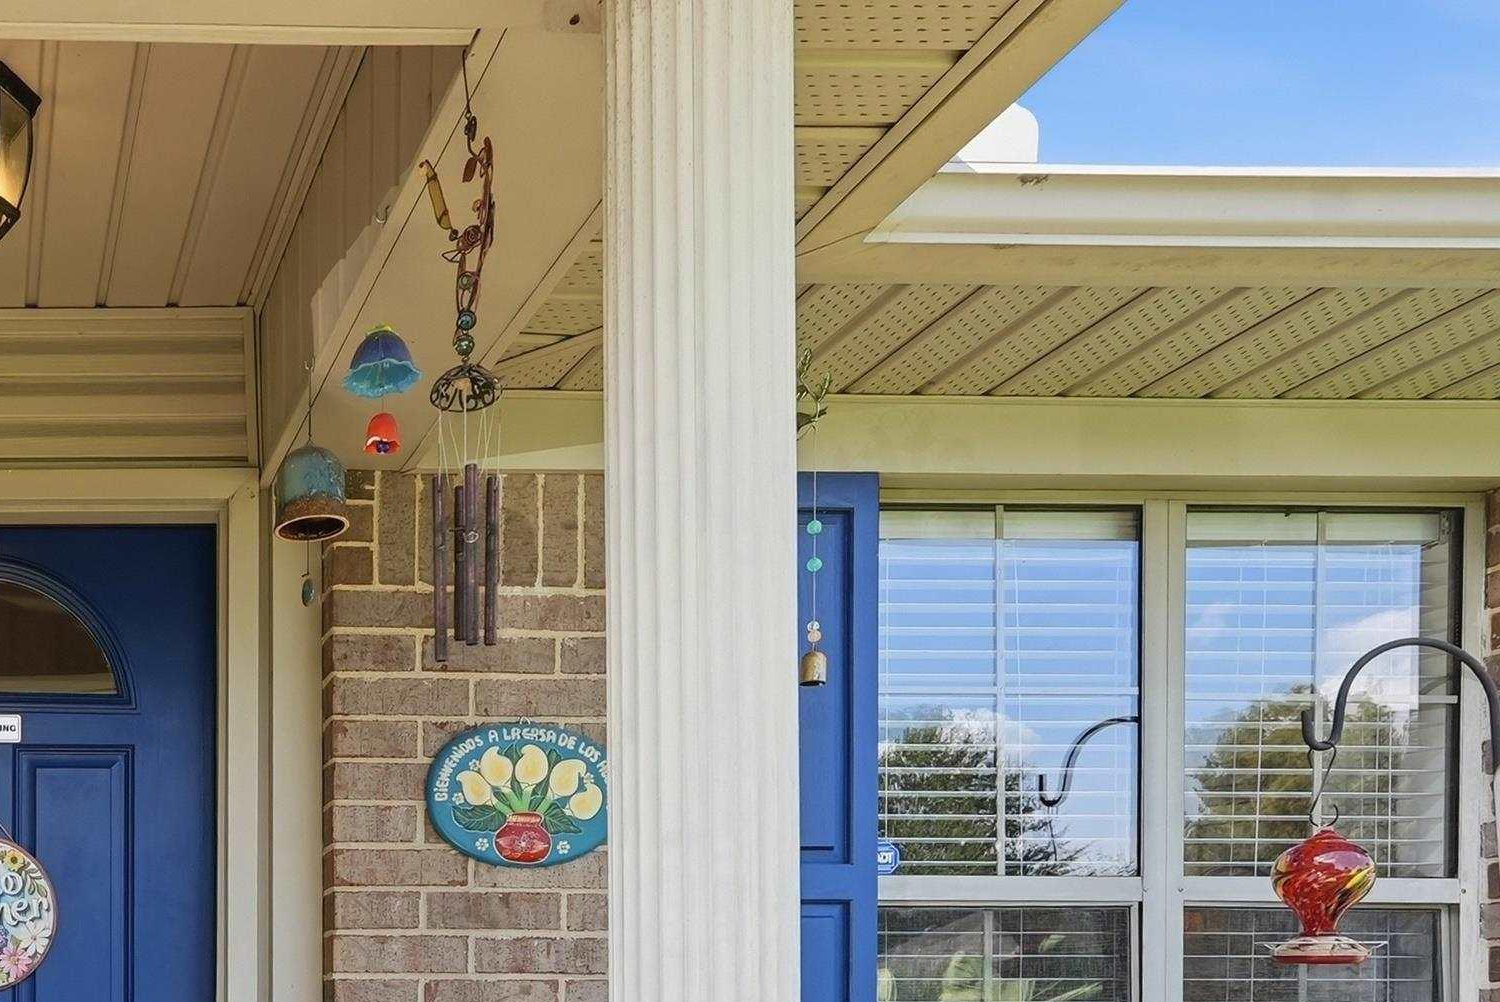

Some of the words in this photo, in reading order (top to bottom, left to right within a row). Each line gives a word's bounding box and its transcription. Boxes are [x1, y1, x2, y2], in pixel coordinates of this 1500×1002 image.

[488, 729, 499, 744] A
[558, 733, 577, 750] DE
[578, 741, 602, 763] LOS
